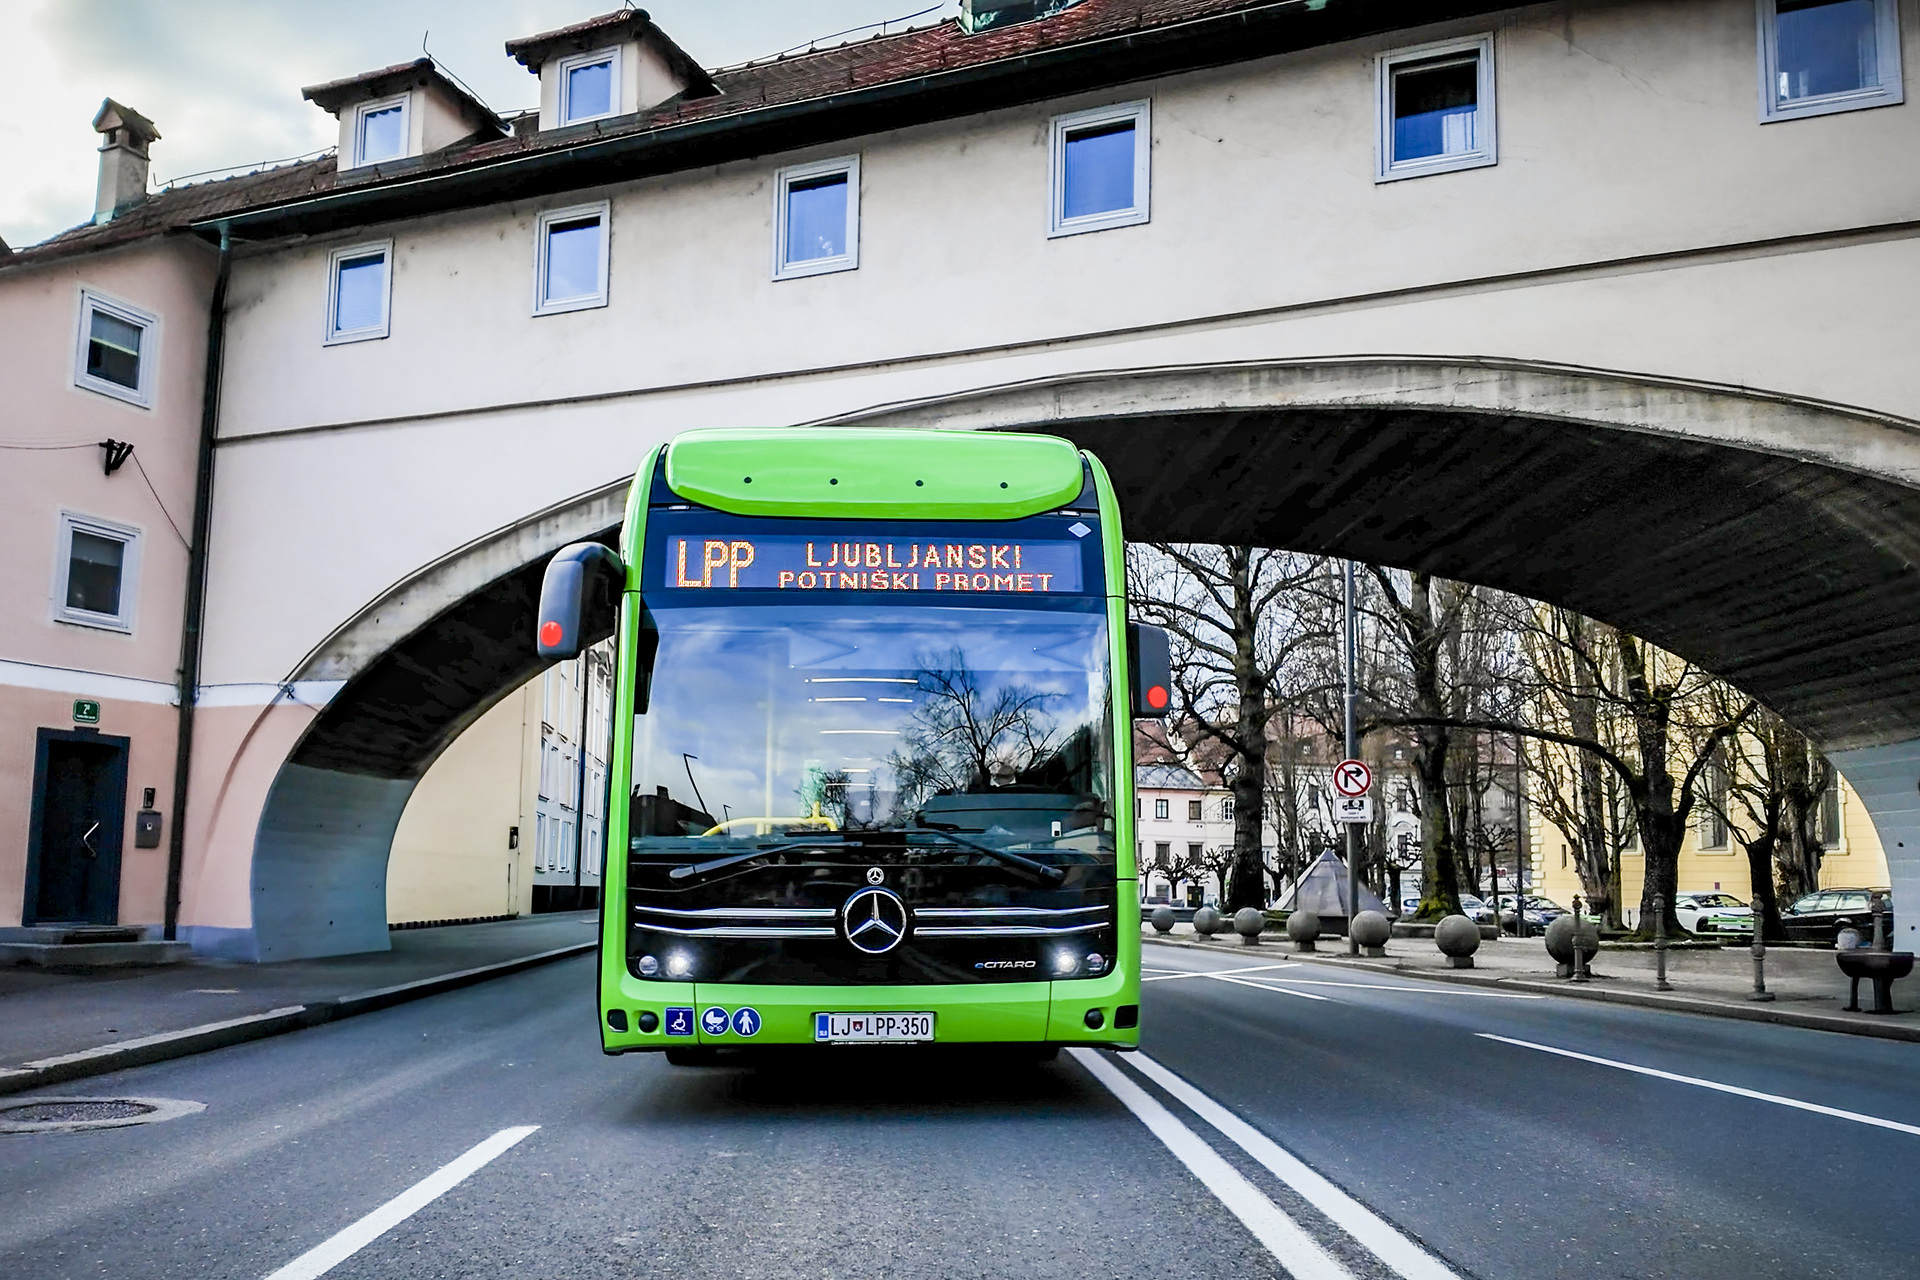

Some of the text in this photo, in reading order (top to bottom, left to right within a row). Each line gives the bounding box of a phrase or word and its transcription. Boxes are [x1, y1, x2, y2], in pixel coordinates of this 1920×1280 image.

[677, 540, 755, 588] LPP
[807, 542, 1022, 569] LJUBLJANSKI
[779, 569, 1053, 592] POTNIŠKI PROMET
[974, 961, 1037, 969] eCITARO
[831, 1017, 929, 1036] LJ LPP-350
